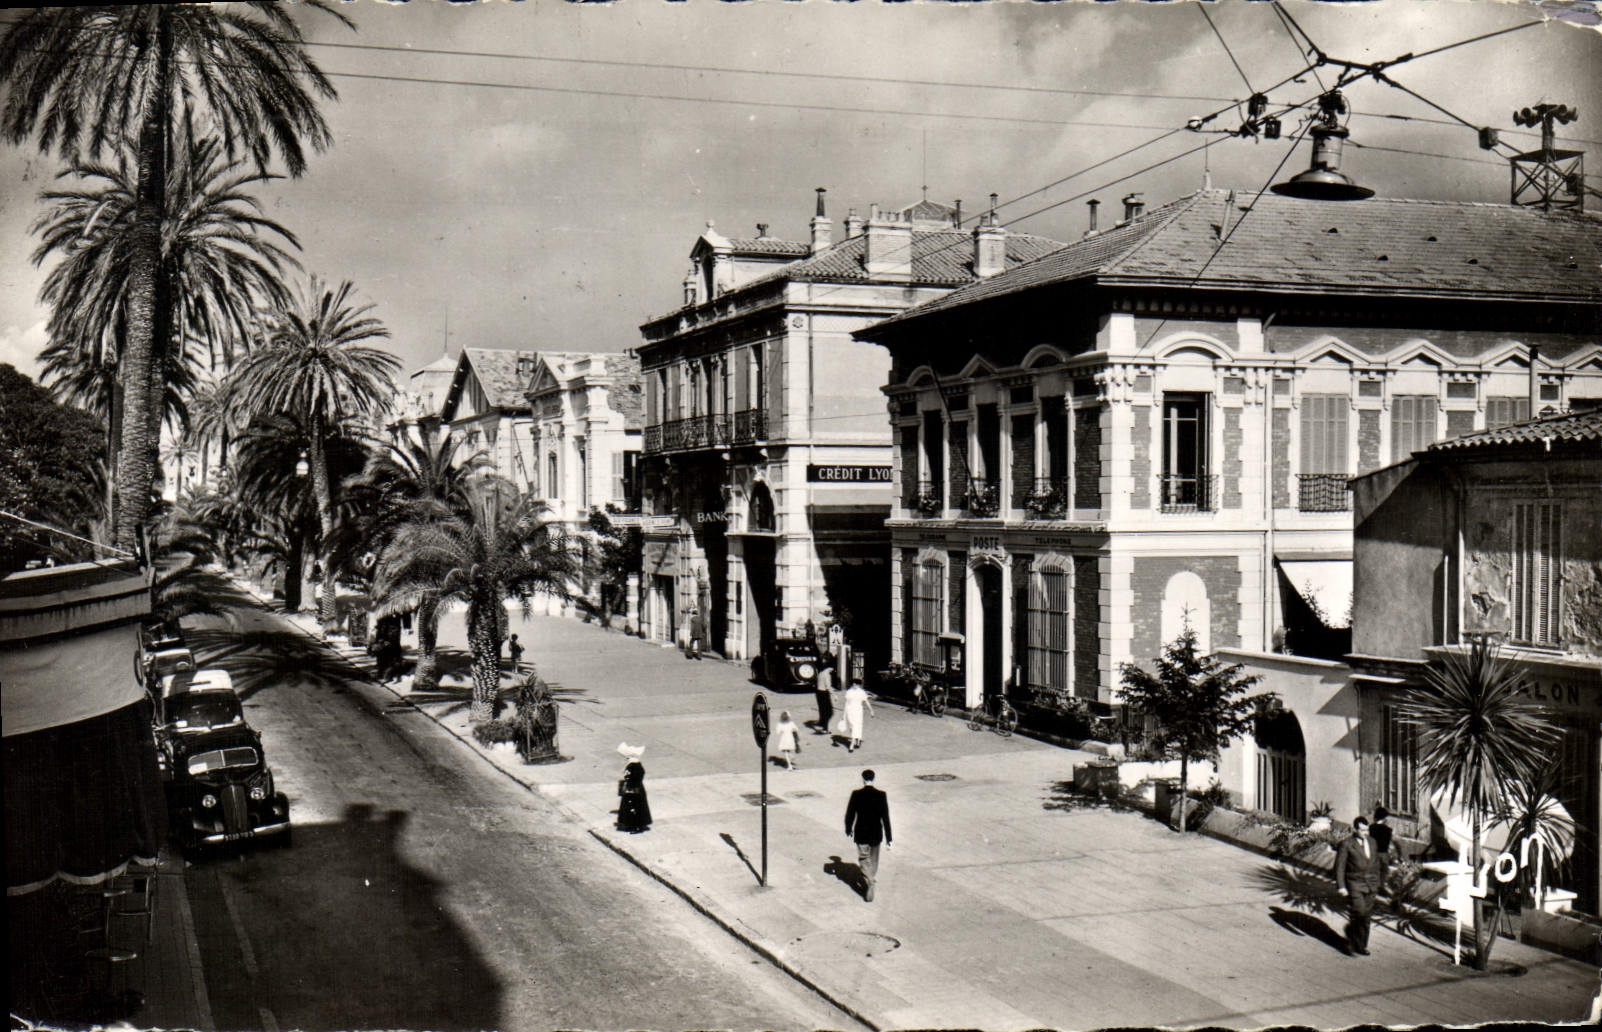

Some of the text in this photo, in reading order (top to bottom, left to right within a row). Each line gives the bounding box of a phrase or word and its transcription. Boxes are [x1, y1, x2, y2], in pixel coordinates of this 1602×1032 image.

[818, 464, 893, 481] CRÉDIT LYO
[973, 536, 1000, 551] POSTE
